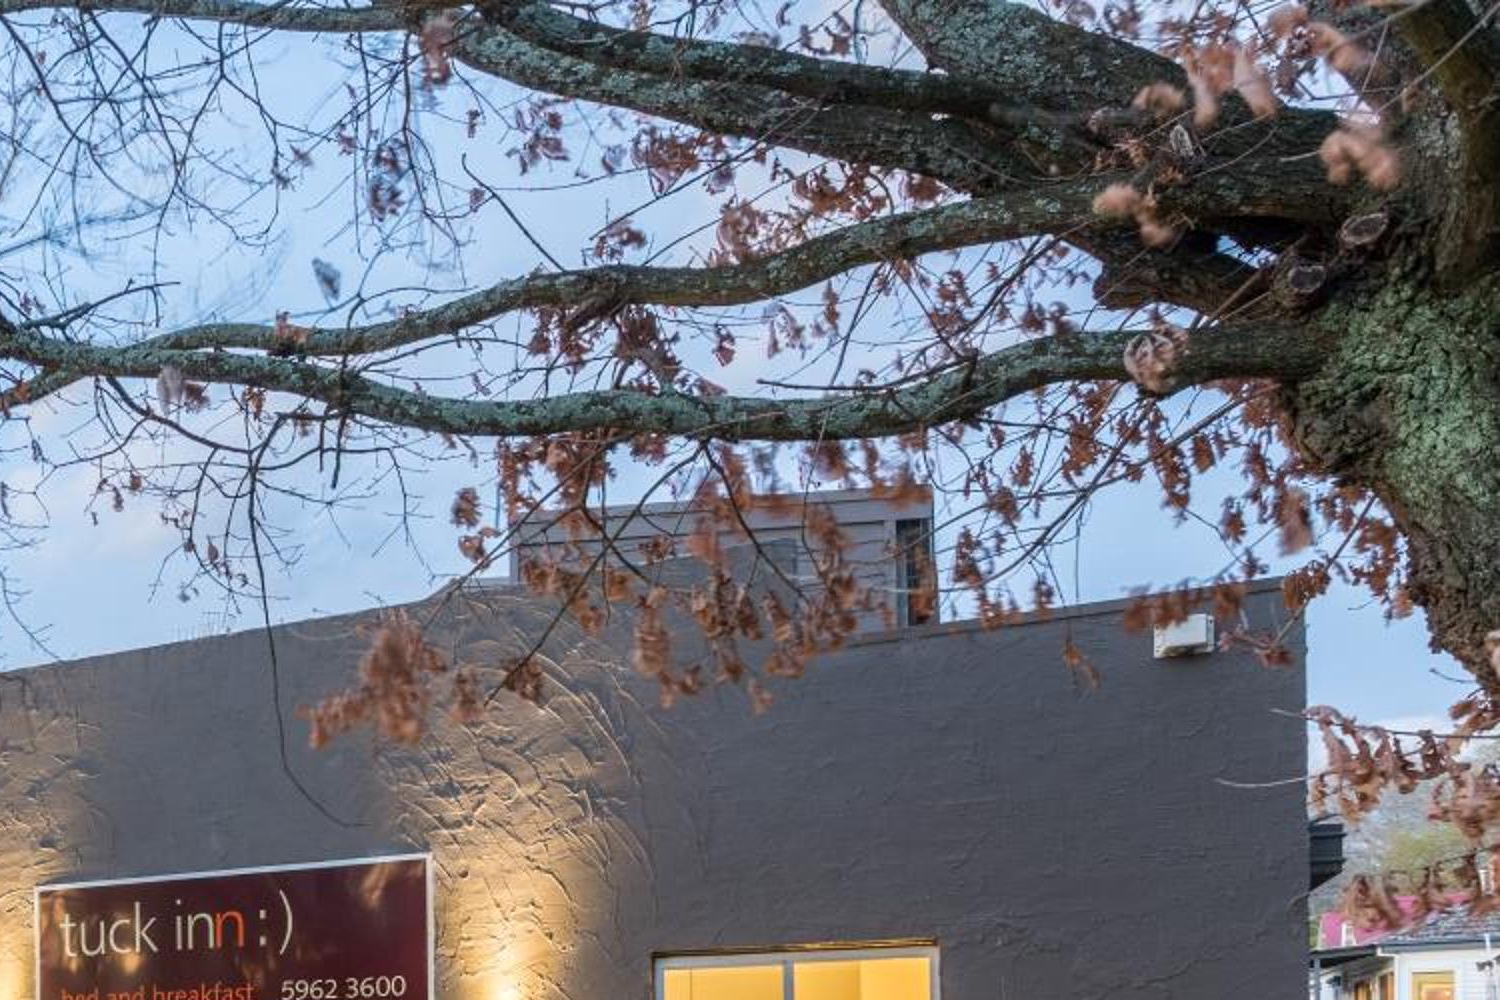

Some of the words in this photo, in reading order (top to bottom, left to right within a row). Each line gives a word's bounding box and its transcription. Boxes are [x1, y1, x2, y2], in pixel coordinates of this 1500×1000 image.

[60, 901, 159, 959] tuck
[175, 899, 246, 951] inn
[346, 974, 407, 999] 3600
